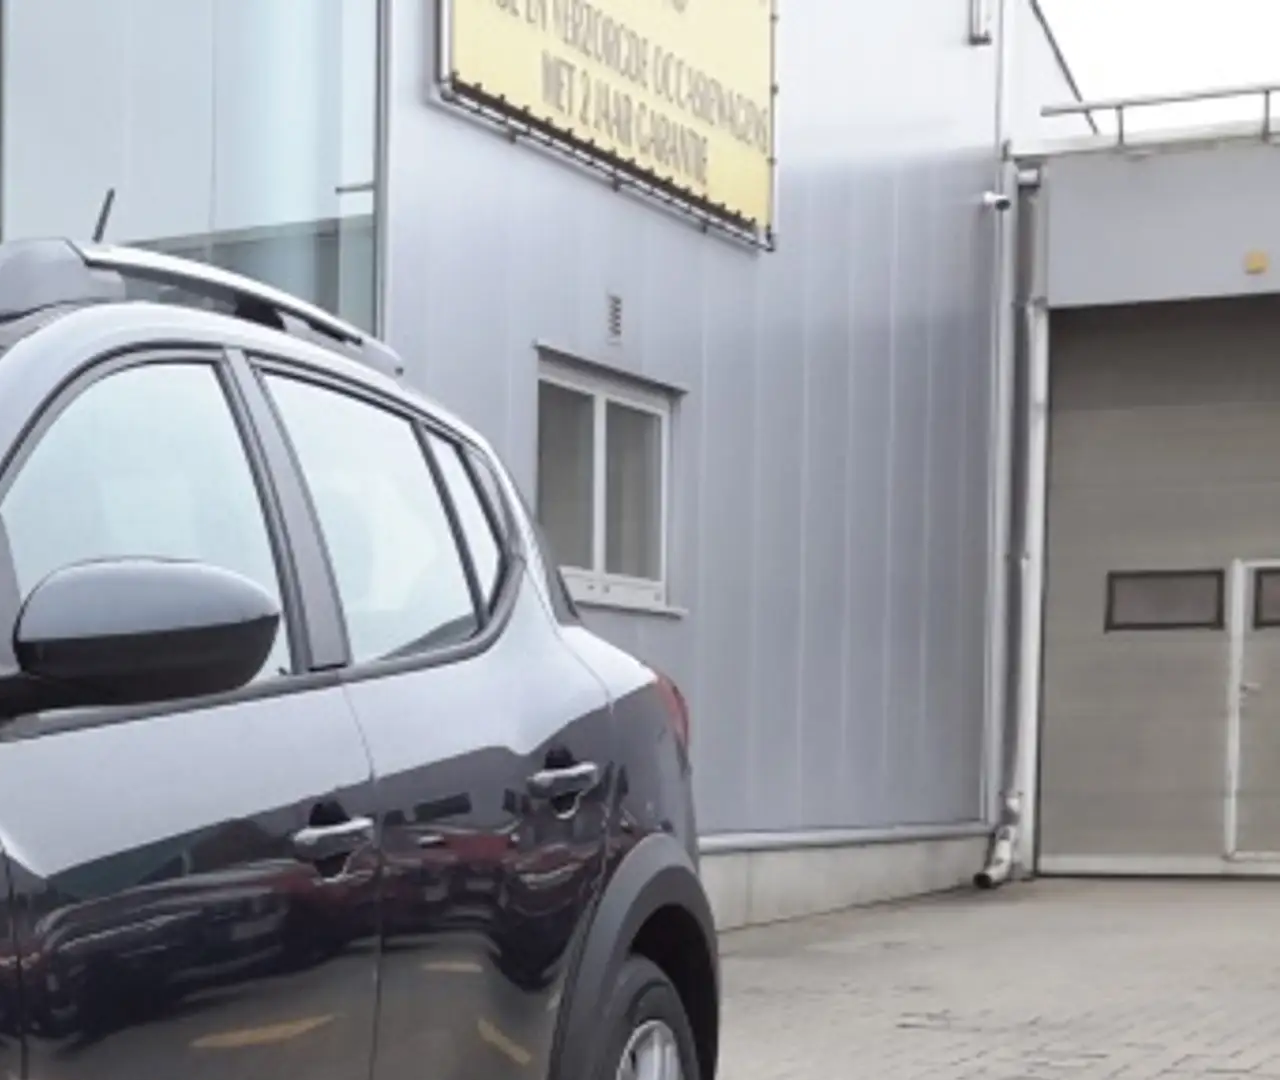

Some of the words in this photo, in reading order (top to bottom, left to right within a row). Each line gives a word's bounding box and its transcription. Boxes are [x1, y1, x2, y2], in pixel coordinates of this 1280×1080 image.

[541, 49, 575, 117] MET
[579, 69, 589, 126] 2
[592, 77, 633, 148] JAAR
[634, 99, 708, 187] GARANTIE
